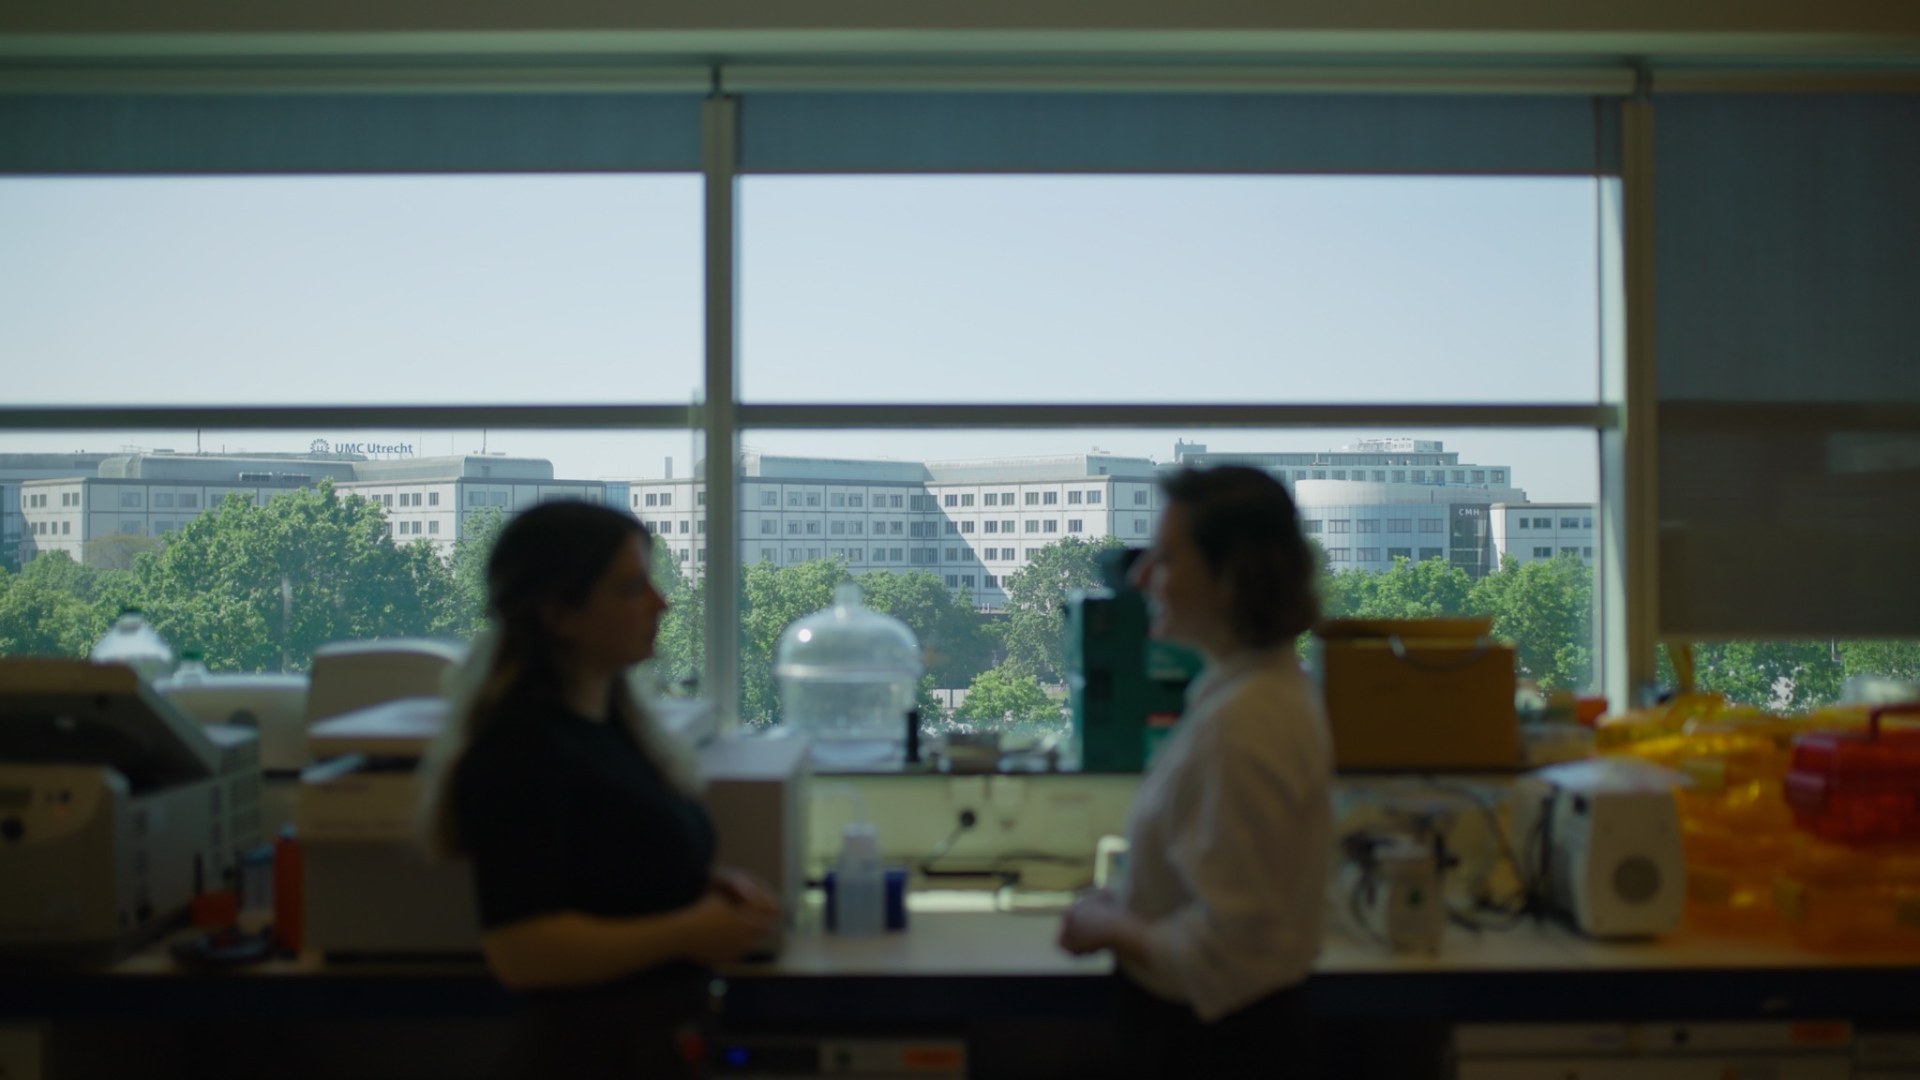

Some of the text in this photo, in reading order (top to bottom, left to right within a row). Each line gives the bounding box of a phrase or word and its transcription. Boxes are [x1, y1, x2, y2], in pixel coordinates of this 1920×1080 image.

[335, 443, 413, 453] UMC Utrecht
[1458, 508, 1480, 516] CMH
